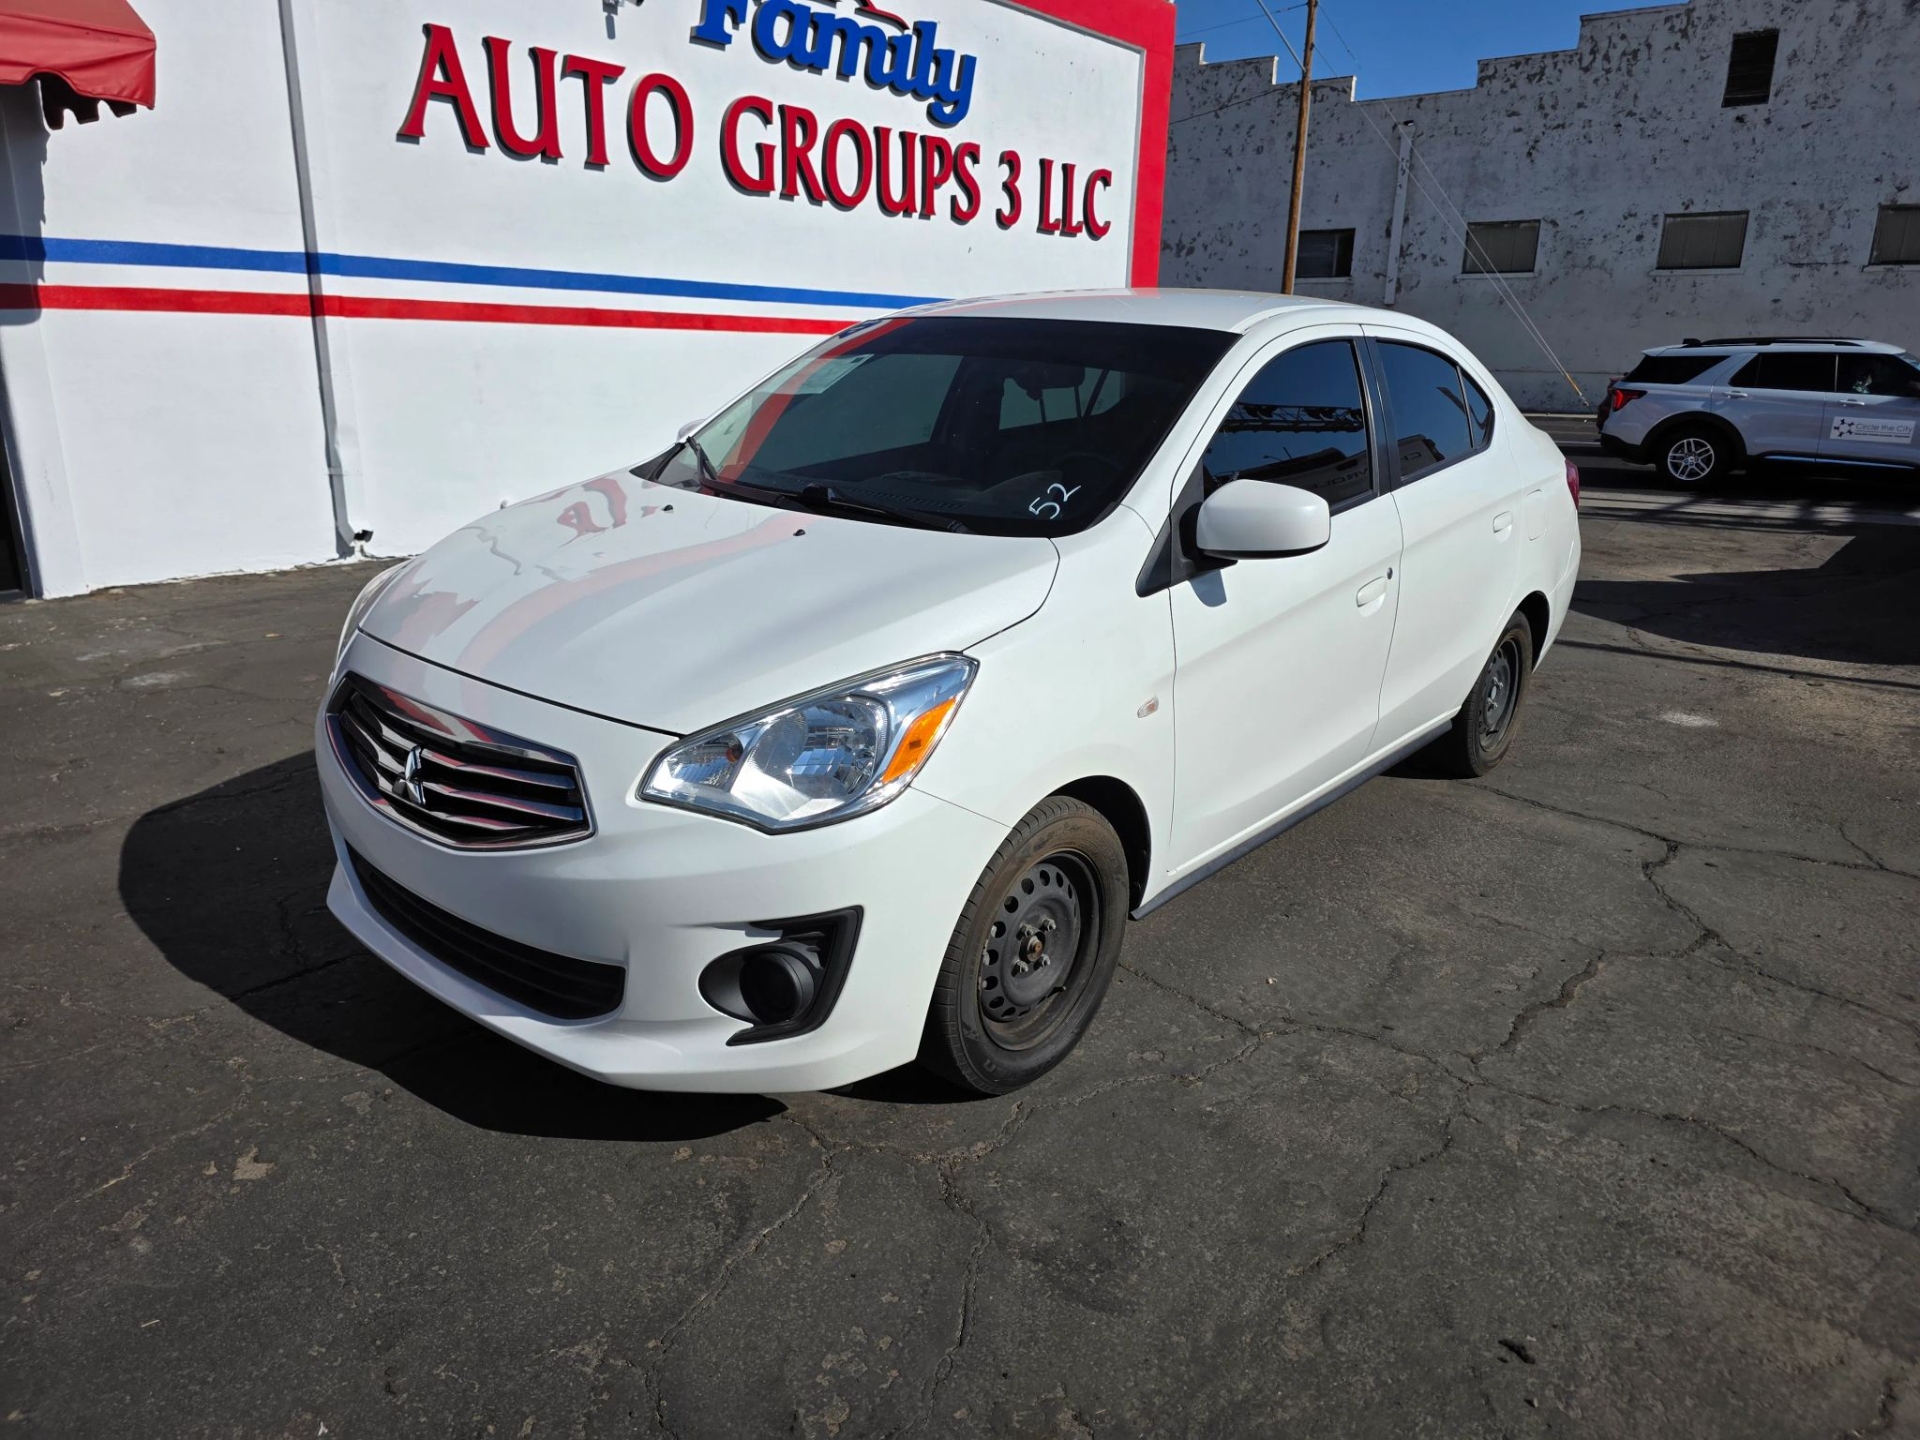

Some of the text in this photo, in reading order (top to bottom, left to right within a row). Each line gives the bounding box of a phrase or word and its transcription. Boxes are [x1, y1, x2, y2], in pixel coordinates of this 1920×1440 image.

[396, 22, 1112, 239] AUTO GROUPS 3 LLC
[1855, 422, 1913, 434] Circle the City
[1028, 482, 1082, 520] 52
